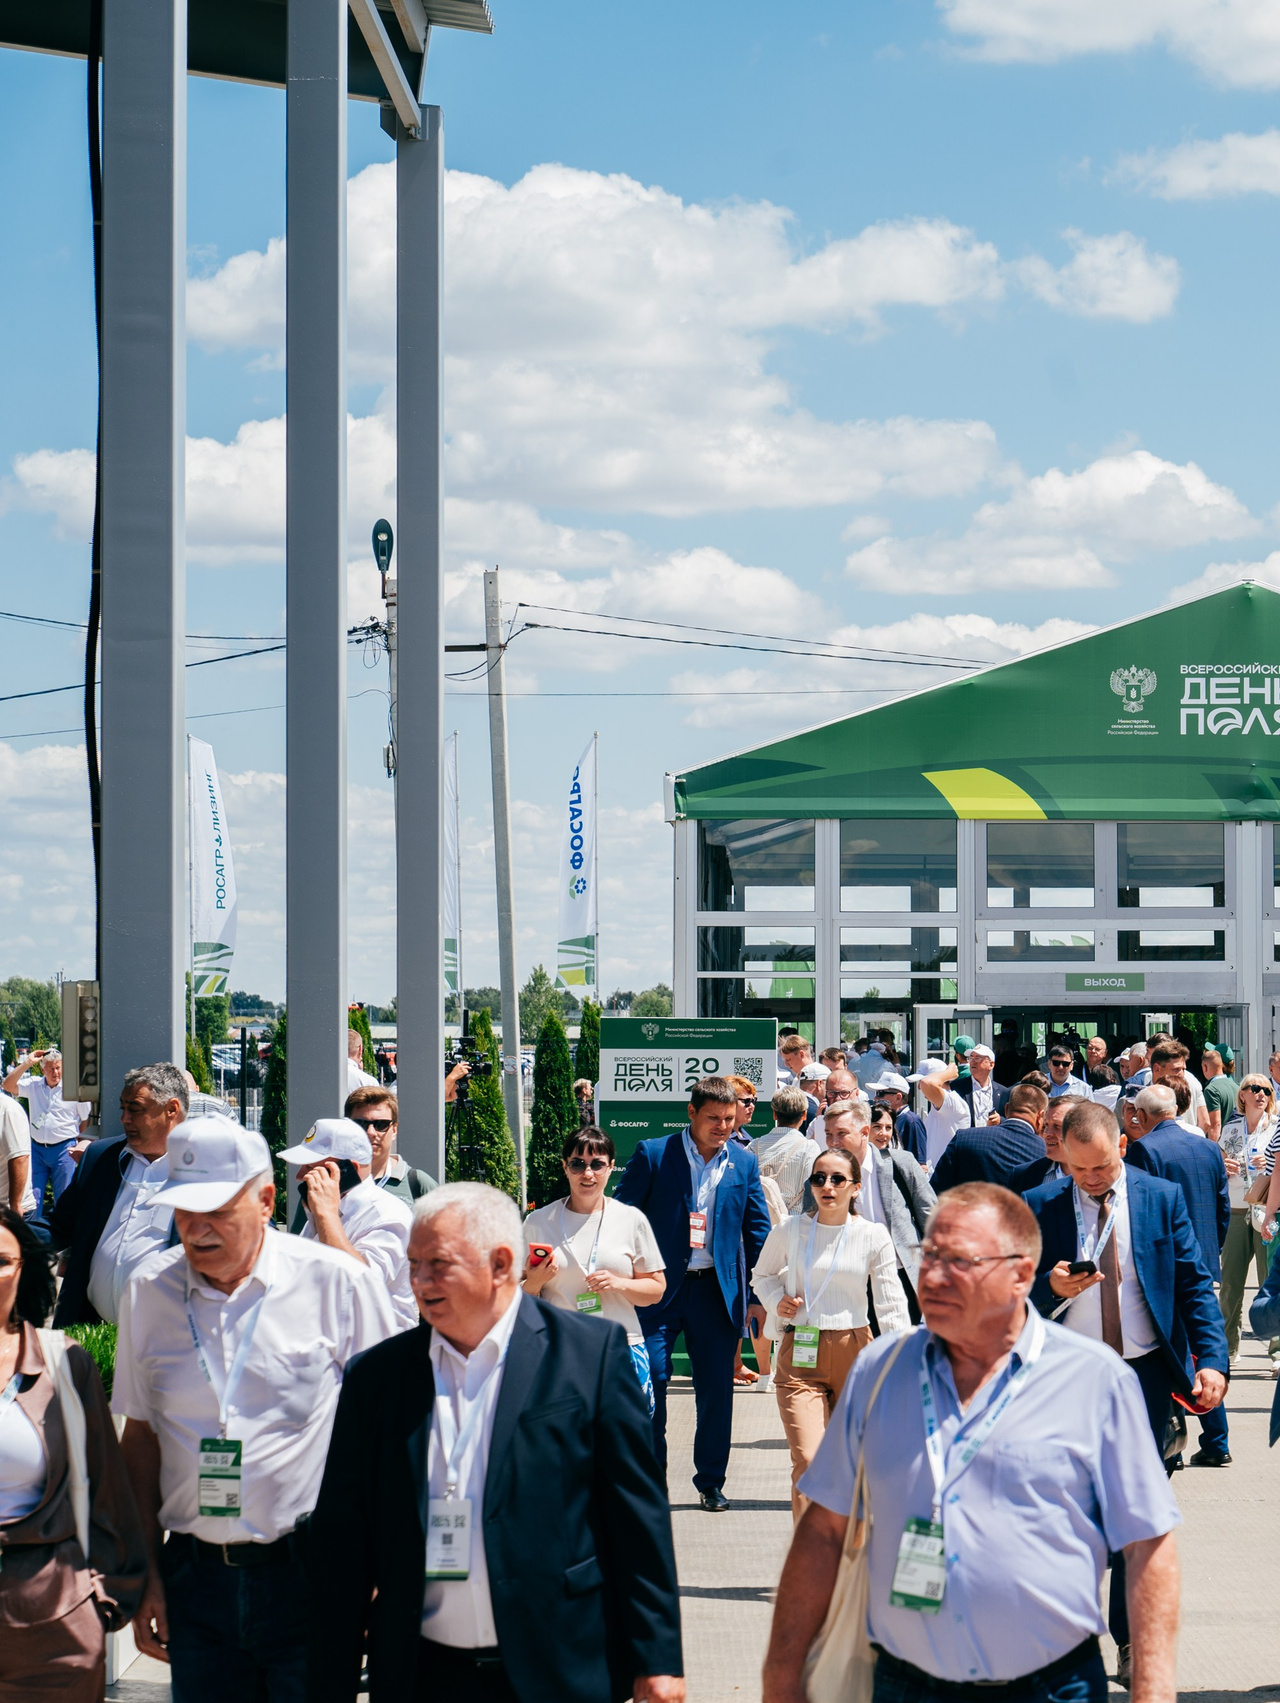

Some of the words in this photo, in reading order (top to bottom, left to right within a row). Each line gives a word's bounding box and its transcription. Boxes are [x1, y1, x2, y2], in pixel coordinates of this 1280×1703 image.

[1084, 978, 1126, 987] ВЫХОД
[614, 1063, 673, 1077] ДЕНЬ
[684, 1057, 720, 1074] 20
[614, 1078, 673, 1092] ПОЛЯ
